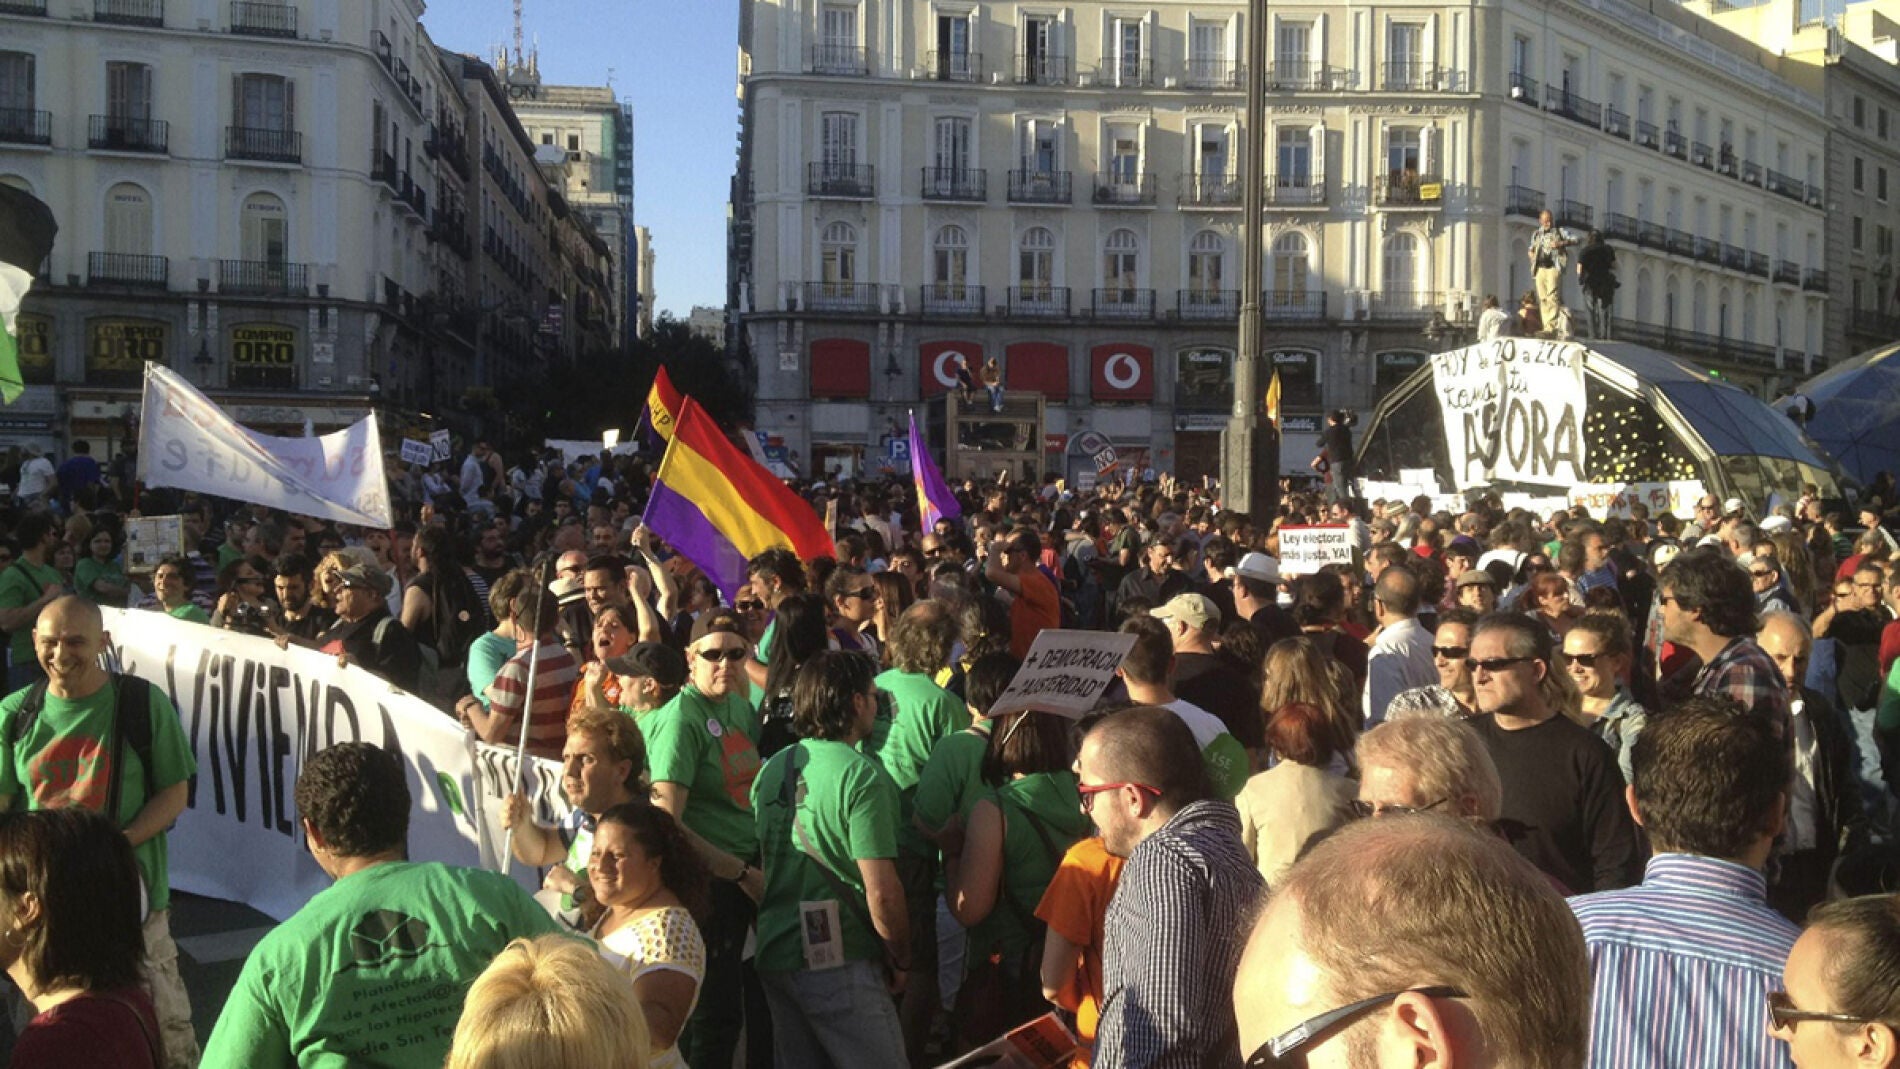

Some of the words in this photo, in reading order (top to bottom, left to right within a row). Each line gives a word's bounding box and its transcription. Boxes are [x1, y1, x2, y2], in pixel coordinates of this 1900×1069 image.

[94, 325, 164, 338] COMPRO
[234, 328, 293, 341] COMPRO
[94, 337, 164, 359] ORO
[233, 341, 294, 363] ORO
[1492, 339, 1517, 366] 20
[1522, 350, 1531, 363] a
[236, 407, 304, 421] DIEGO
[893, 441, 906, 458] P
[1283, 532, 1301, 546] Ley
[1302, 532, 1345, 544] electoral
[1332, 547, 1350, 559] YA!
[1038, 648, 1123, 672] DEMOCRACIA
[38, 757, 105, 785] STOP
[343, 1009, 362, 1022] de
[396, 1033, 424, 1048] Sin
